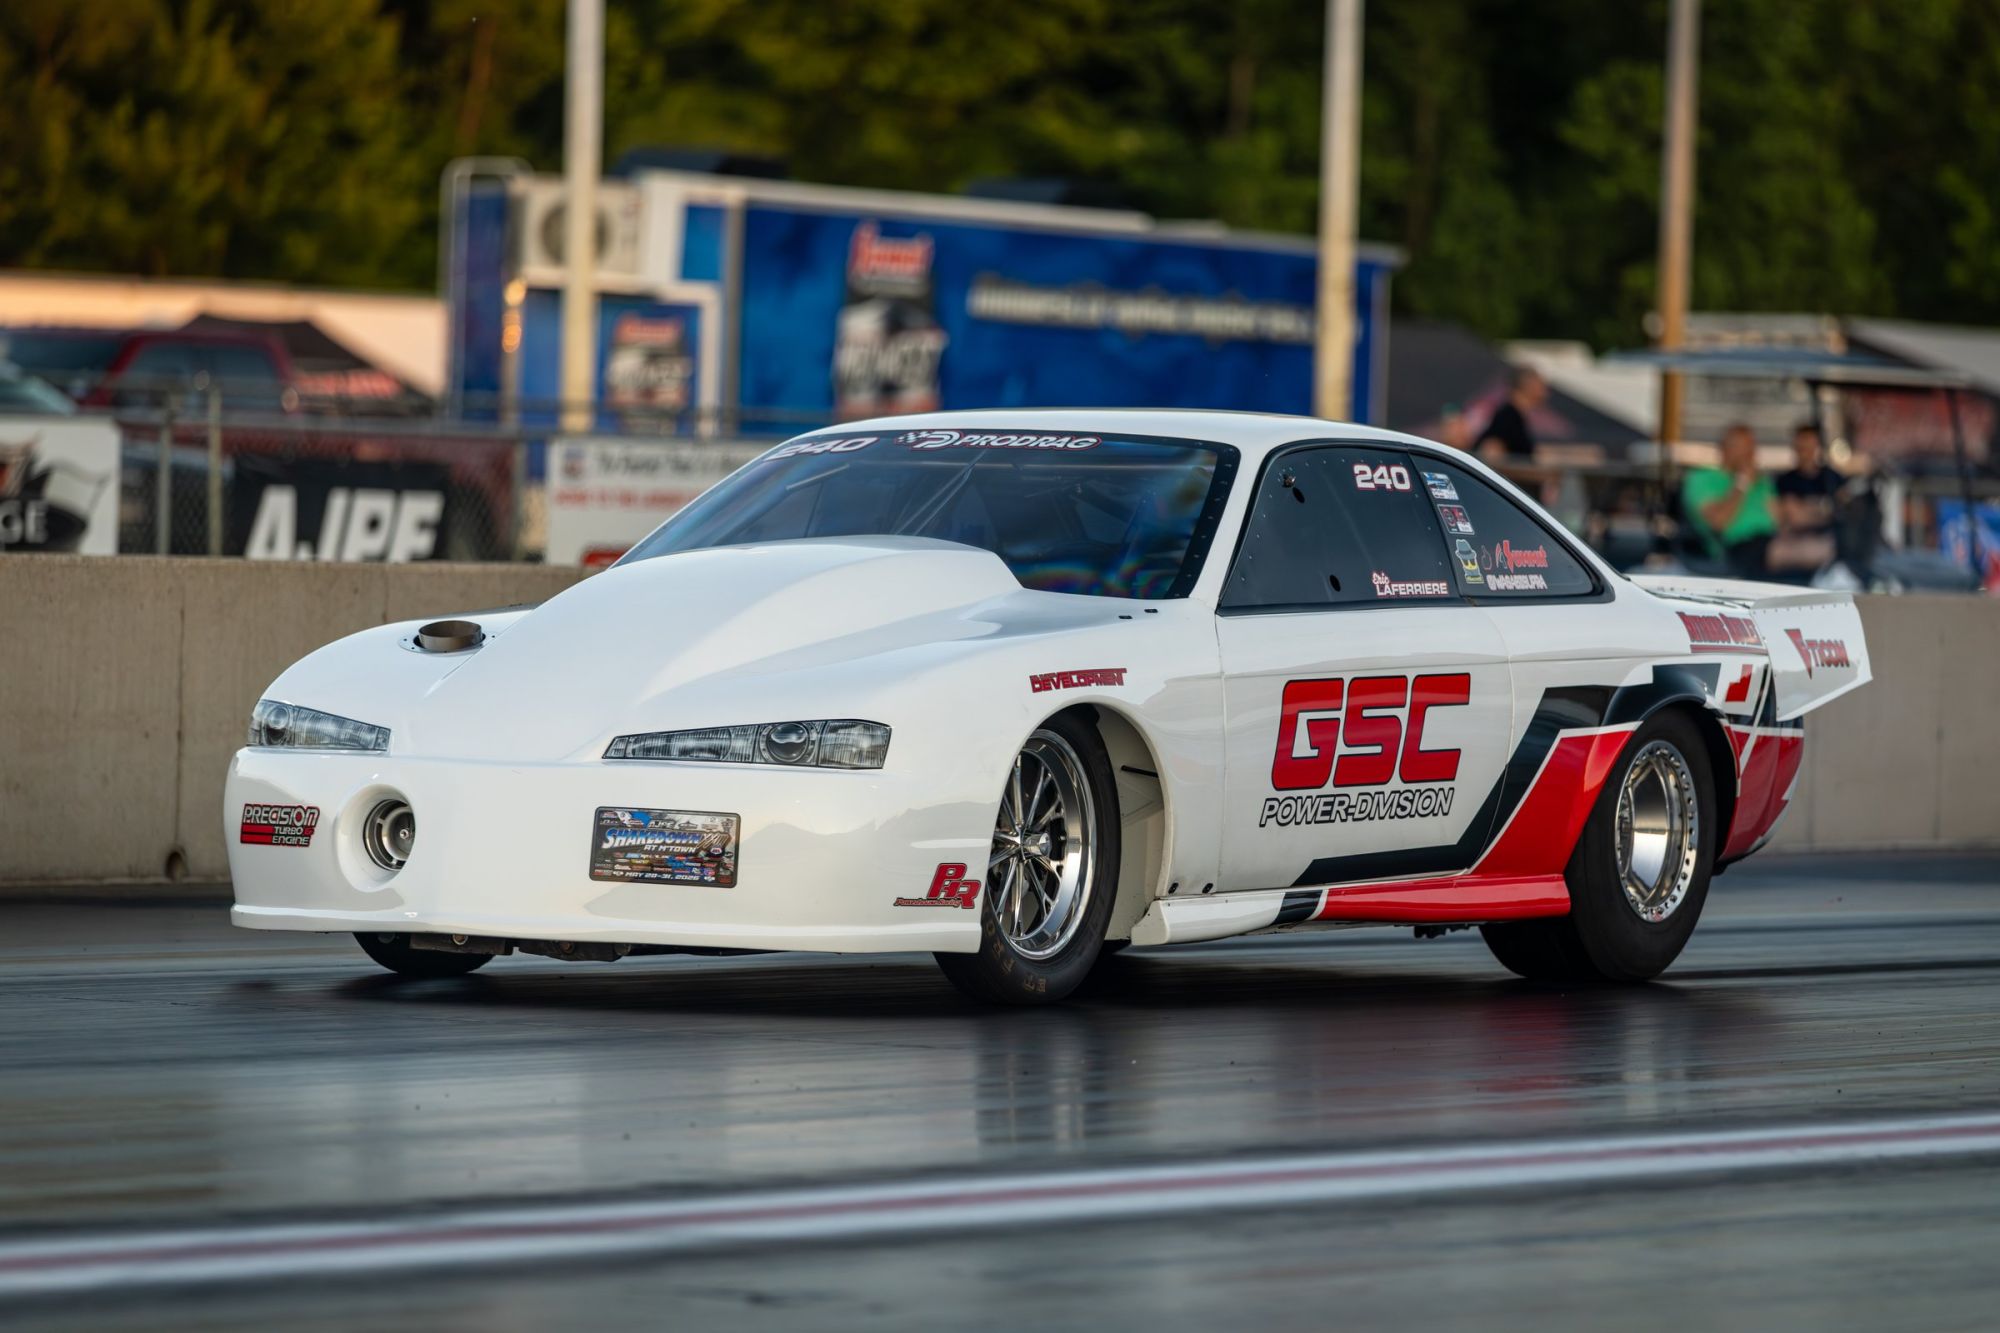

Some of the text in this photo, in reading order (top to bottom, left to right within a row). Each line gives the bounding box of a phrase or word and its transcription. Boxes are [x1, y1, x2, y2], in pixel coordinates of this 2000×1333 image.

[763, 437, 879, 461] 240
[956, 433, 1101, 450] PRODRAG
[1353, 464, 1411, 490] 240
[1376, 581, 1449, 597] LAFERRIERE
[1271, 673, 1471, 791] GSC
[242, 804, 320, 827] PRECISION
[1259, 787, 1455, 828] POWER-DIVISION
[274, 826, 303, 835] TURBO
[601, 828, 701, 849] SHAKEDOWN
[272, 835, 311, 846] ENGINE
[643, 844, 657, 852] AT
[625, 871, 644, 879] MAY
